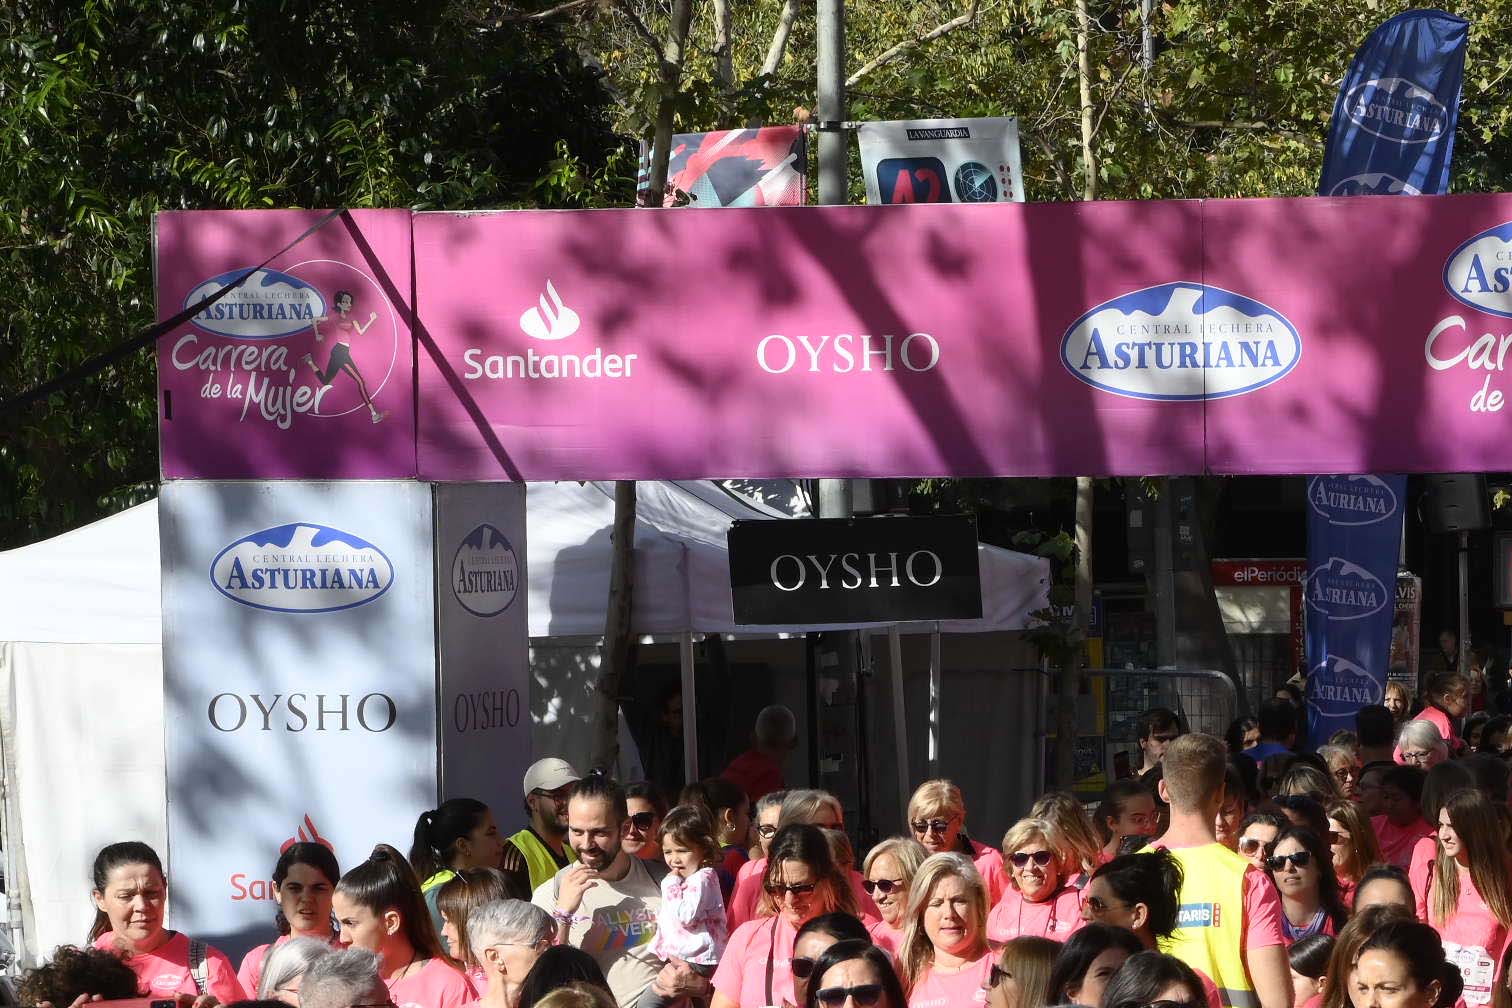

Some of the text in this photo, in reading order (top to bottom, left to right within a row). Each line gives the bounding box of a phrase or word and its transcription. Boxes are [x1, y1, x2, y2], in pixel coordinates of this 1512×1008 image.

[1080, 327, 1282, 370] ASTURIANA
[1116, 323, 1192, 335] CENTRAL
[172, 333, 290, 373] Carrera
[464, 348, 637, 379] Santander
[756, 333, 940, 374] OYSHO
[201, 373, 242, 400] de la
[240, 366, 332, 429] Mujer
[1470, 374, 1504, 413] de
[225, 556, 381, 591] ASTURIANA
[457, 563, 515, 595] ASTURIANA
[769, 550, 943, 591] OYSHO
[207, 692, 399, 733] OYSHO
[455, 688, 520, 734] OYSHO
